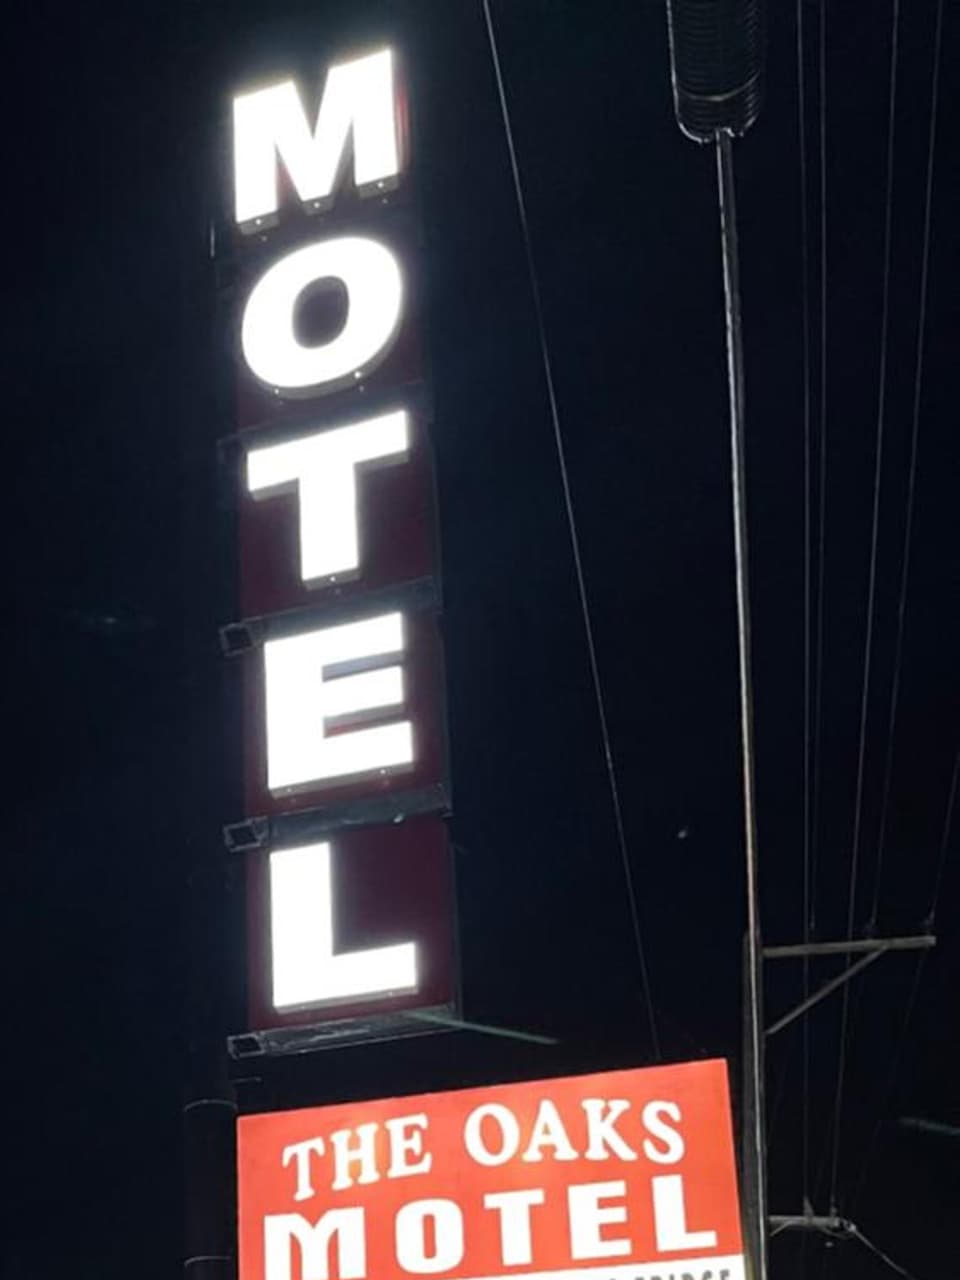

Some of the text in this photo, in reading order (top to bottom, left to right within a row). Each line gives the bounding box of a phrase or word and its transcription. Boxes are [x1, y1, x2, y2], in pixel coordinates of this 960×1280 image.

[233, 48, 420, 1010] MOTEL
[283, 1098, 686, 1201] THE OAKS
